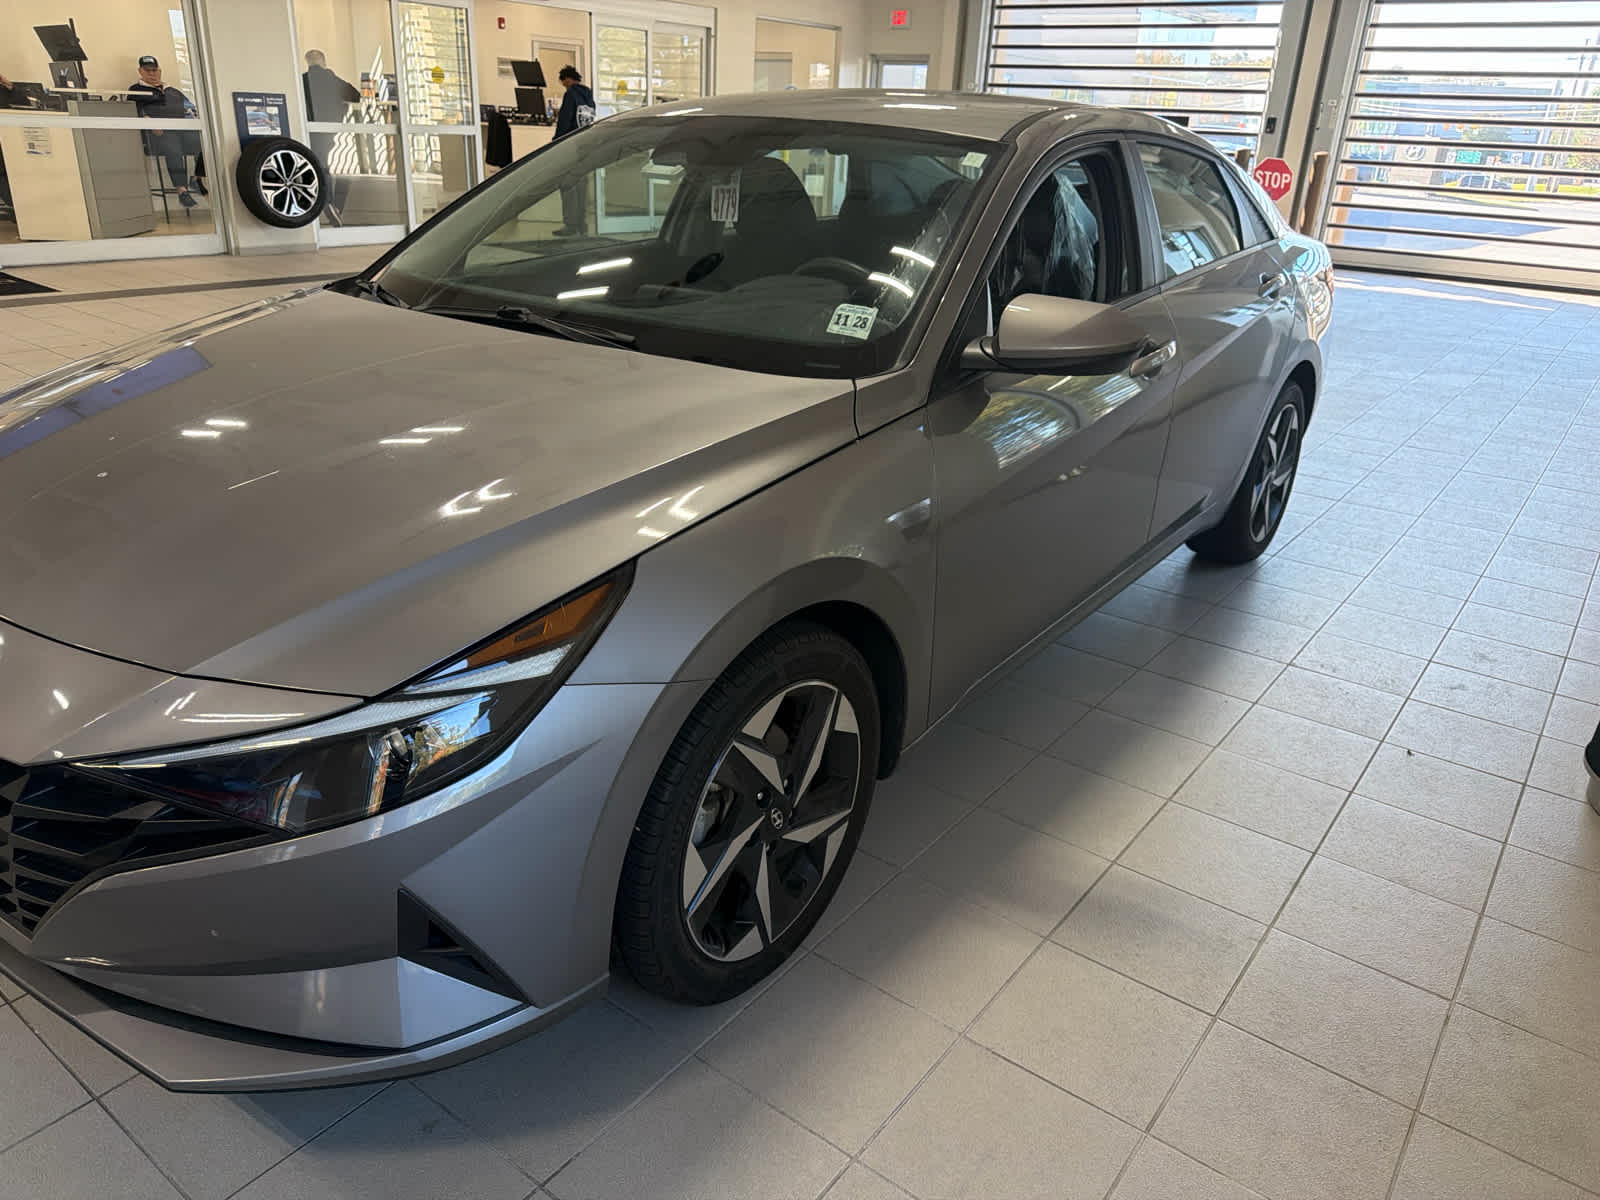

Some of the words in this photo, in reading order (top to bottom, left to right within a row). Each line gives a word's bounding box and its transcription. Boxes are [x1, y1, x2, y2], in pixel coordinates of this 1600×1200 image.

[1255, 170, 1291, 190] STOP
[833, 313, 850, 327] 11
[852, 315, 870, 329] 28
